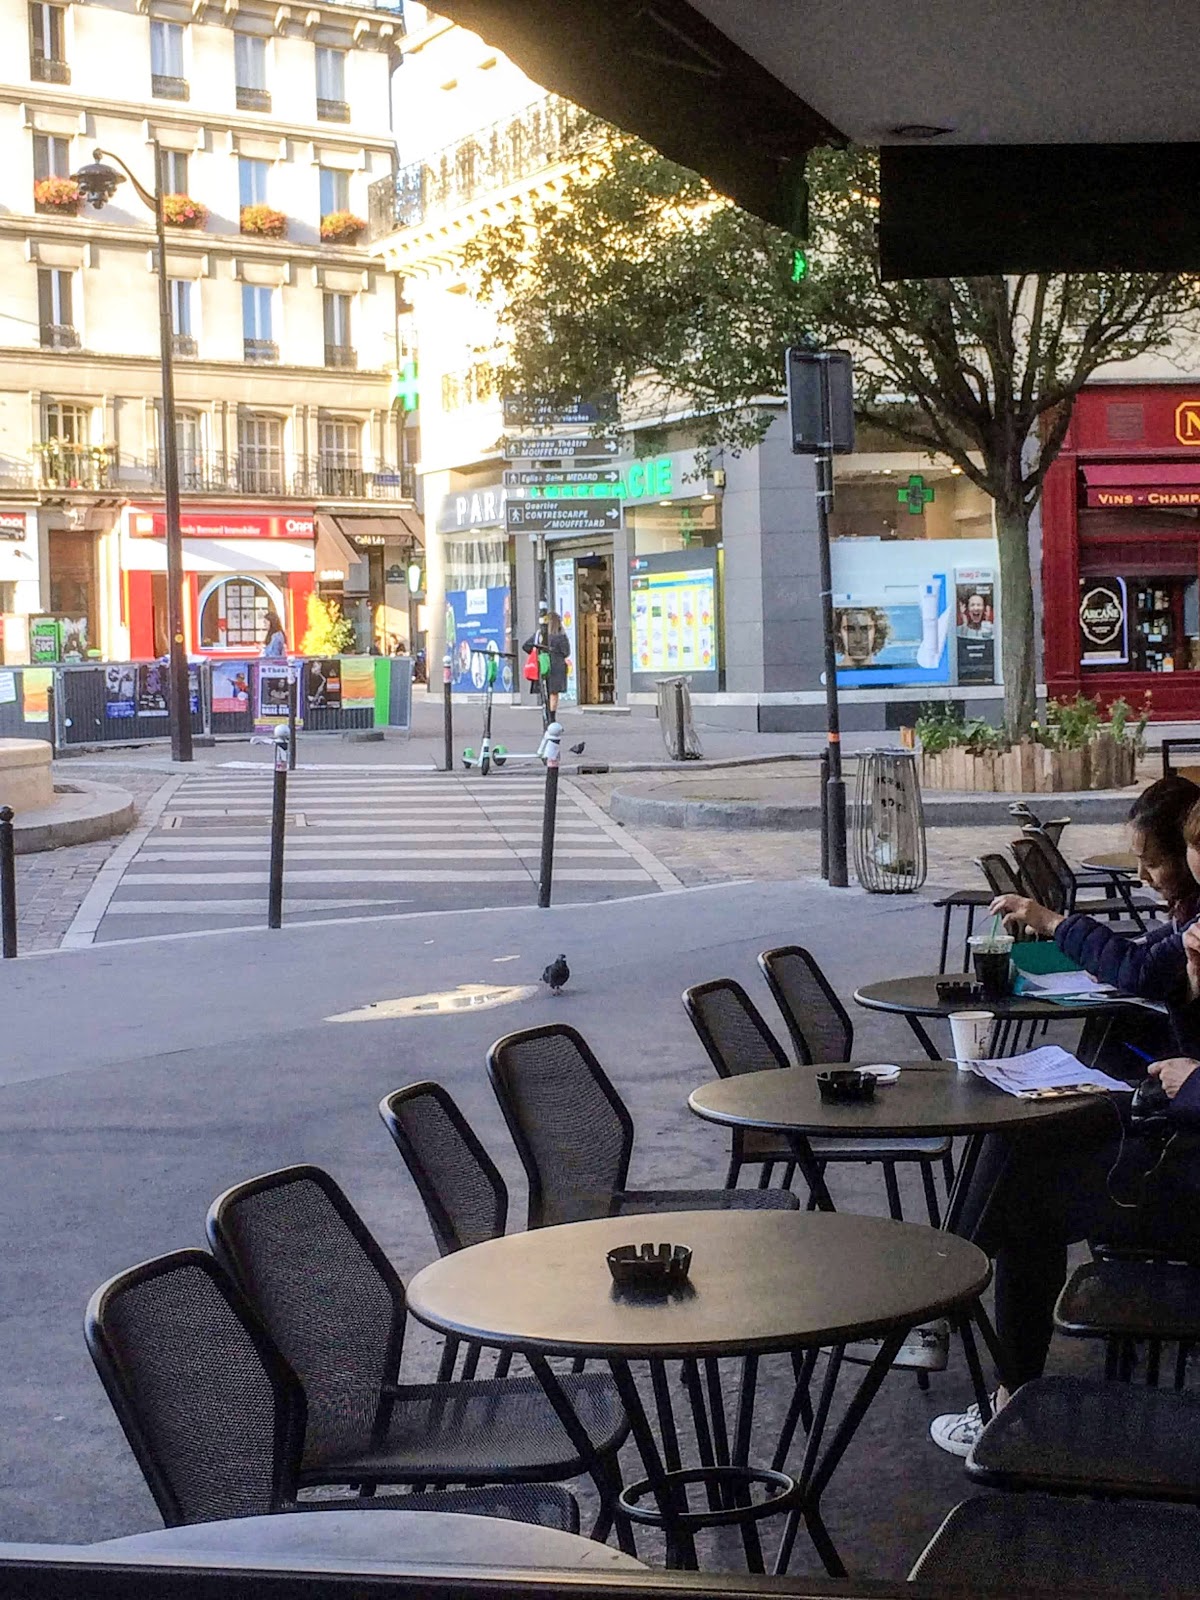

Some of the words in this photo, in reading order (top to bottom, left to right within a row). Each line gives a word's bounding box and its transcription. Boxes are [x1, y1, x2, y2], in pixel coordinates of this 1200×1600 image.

[521, 447, 575, 456] MOUFFETARD
[545, 474, 564, 482] Saint
[566, 473, 599, 481] MEDARD
[524, 502, 559, 510] Quartier
[524, 510, 588, 519] CONTRESCARPE
